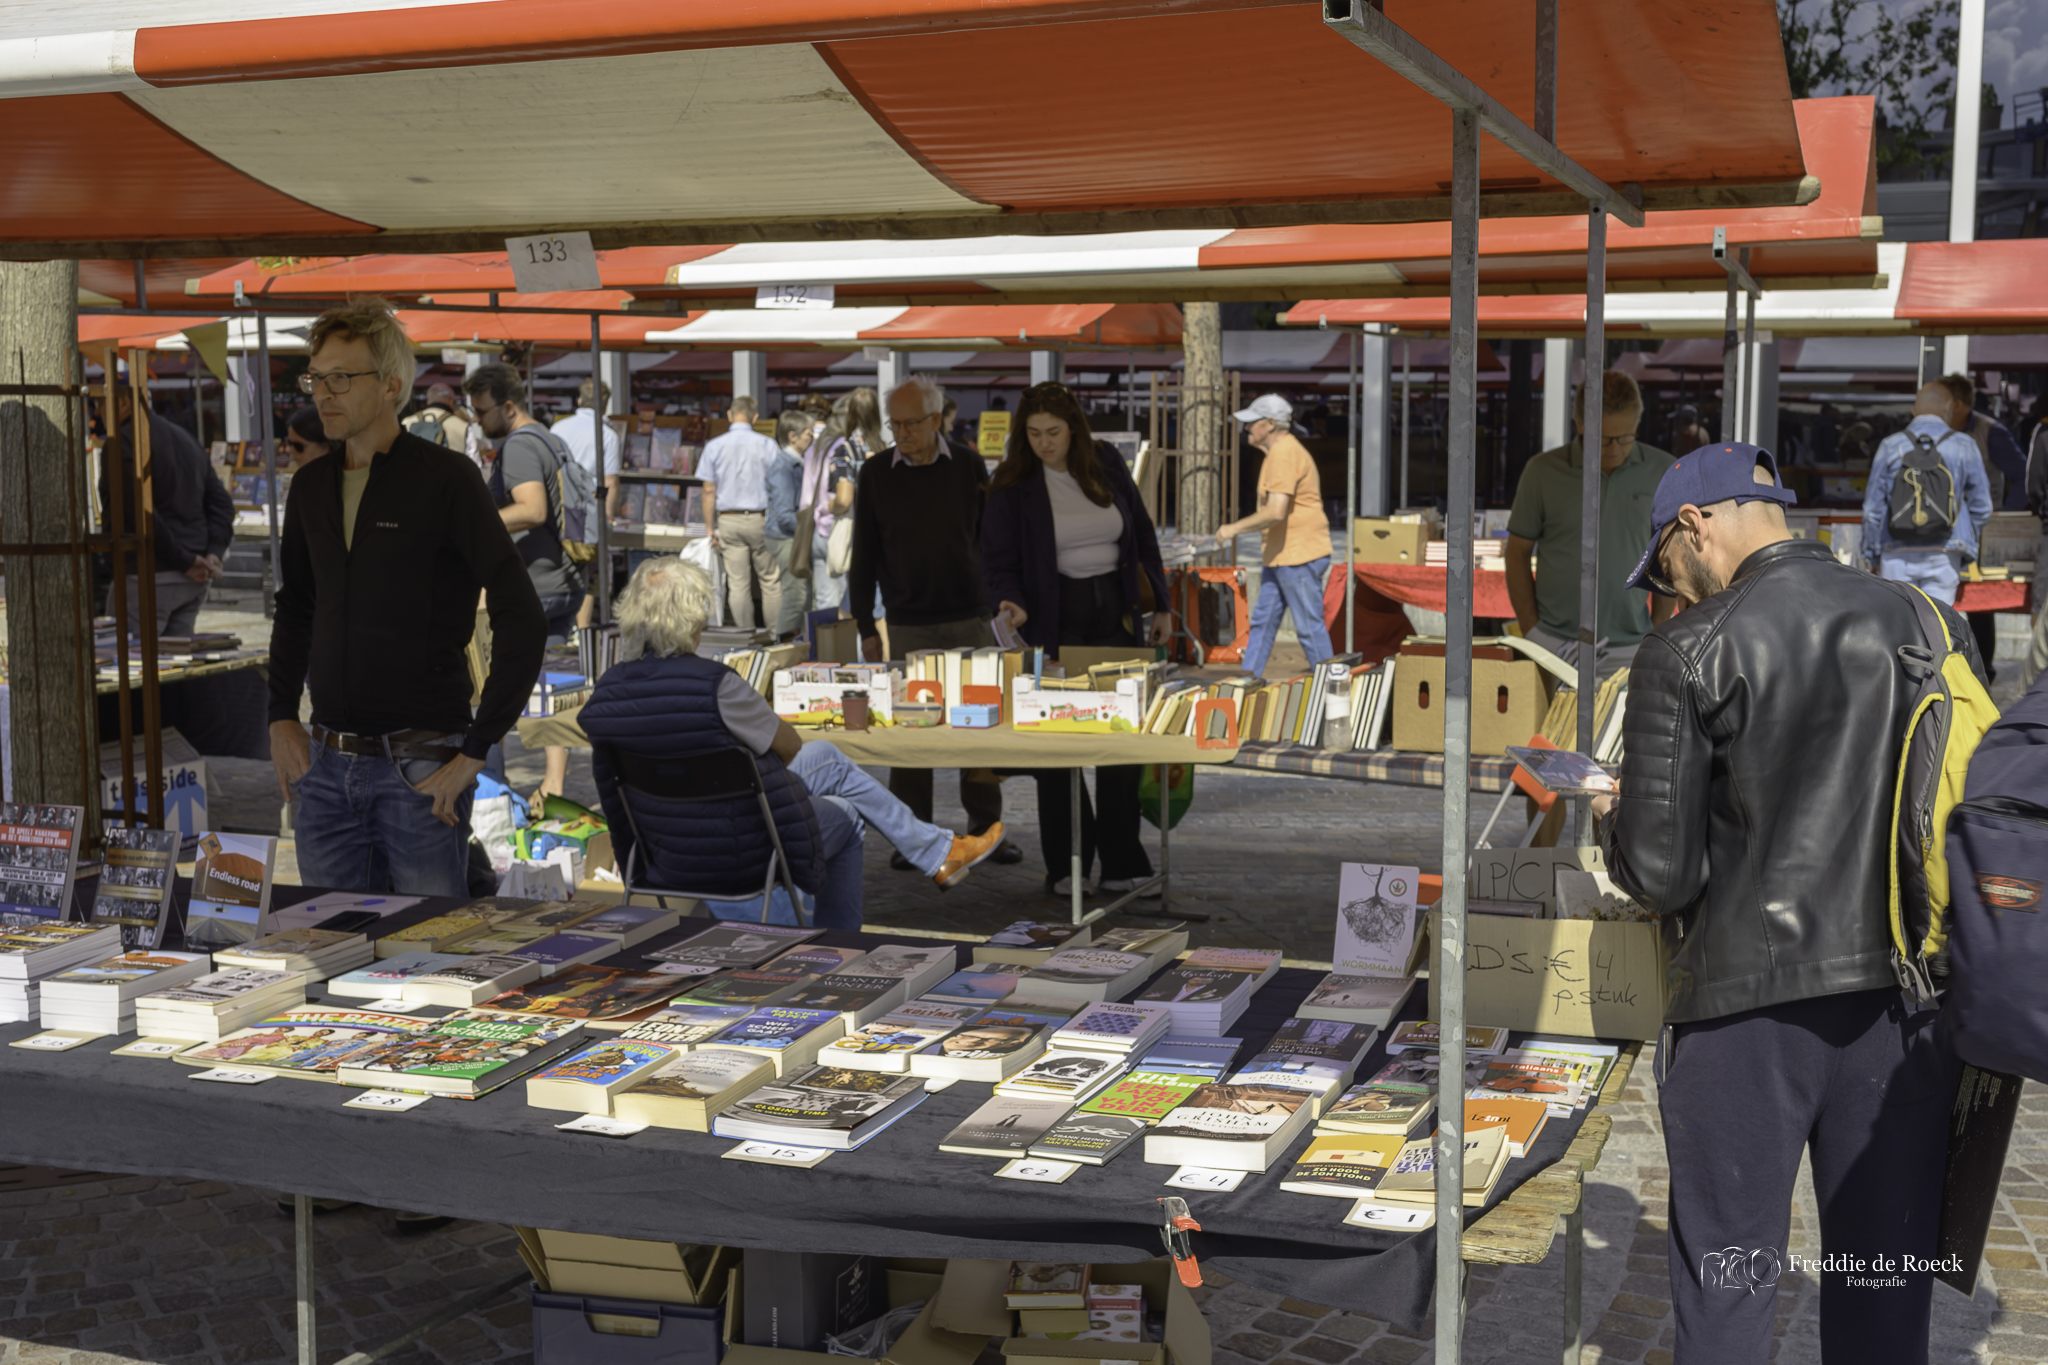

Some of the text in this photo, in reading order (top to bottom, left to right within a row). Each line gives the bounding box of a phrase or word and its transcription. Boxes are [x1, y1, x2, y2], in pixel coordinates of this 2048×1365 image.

[525, 239, 567, 265] 133
[772, 284, 807, 304] 152
[209, 868, 260, 892] Endless road
[651, 952, 716, 964] ELVIS
[1063, 953, 1133, 965] BROWN
[1084, 951, 1124, 960] DAN
[1341, 959, 1403, 974] WORMMAAN
[1596, 950, 1614, 981] 4
[823, 980, 885, 990] WINTER
[825, 974, 895, 985] LEON DE
[770, 1009, 820, 1017] RASCHA
[771, 1012, 809, 1020] PEPER
[901, 1007, 957, 1020] KOLYMA
[286, 1012, 335, 1023] THE
[338, 1013, 429, 1031] BEATLE
[465, 1020, 524, 1033] 1000
[633, 1021, 721, 1035] LEON DE
[746, 1024, 796, 1032] SCHEEP
[437, 1027, 527, 1042] VOETBALLERS
[619, 1028, 704, 1042] WINTER
[50, 1039, 65, 1047] 15
[152, 1044, 173, 1052] 10
[1510, 1063, 1560, 1074] italiaans
[551, 1070, 604, 1080] HAAR
[1136, 1072, 1181, 1083] TIM
[1116, 1085, 1185, 1099] TAFEL
[1120, 1081, 1170, 1092] EEN
[387, 1097, 403, 1106] 8
[1102, 1096, 1158, 1108] VLIN
[1132, 1094, 1178, 1105] VOL
[754, 1103, 800, 1115] CLOSING
[1097, 1103, 1166, 1115] DERS
[1176, 1114, 1269, 1128] GRISHAM
[1200, 1110, 1255, 1121] JOHN
[1043, 1139, 1062, 1147] AAN
[1044, 1136, 1079, 1145] FIETSEN
[1052, 1133, 1112, 1143] FRANK HEINEN
[743, 1144, 810, 1160] € 15
[1019, 1167, 1049, 1176] € 2
[1326, 1167, 1361, 1175] HOOG
[1179, 1173, 1229, 1187] € 4
[1335, 1173, 1372, 1181] STOND
[1364, 1209, 1417, 1223] € 1
